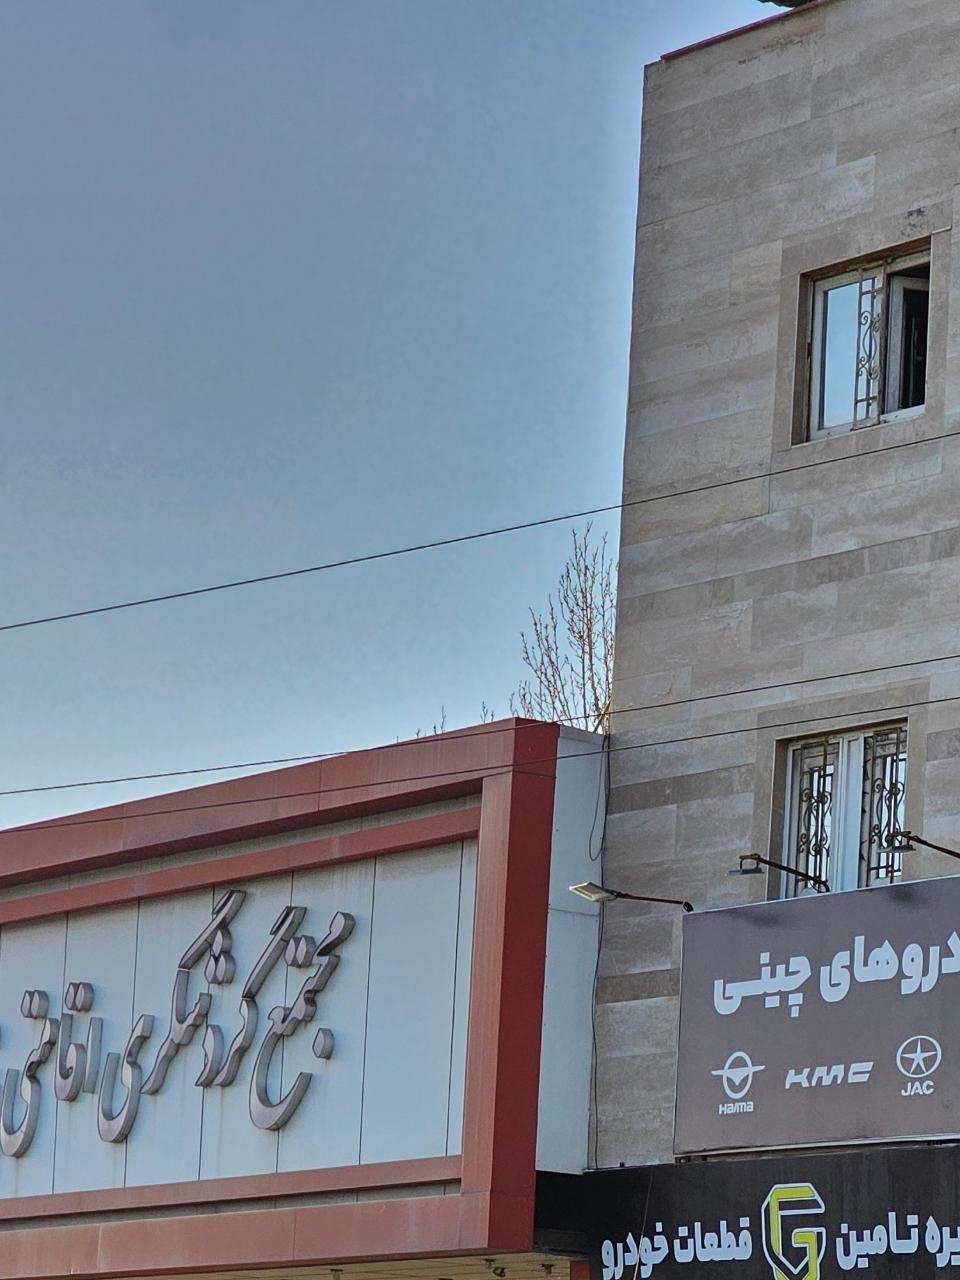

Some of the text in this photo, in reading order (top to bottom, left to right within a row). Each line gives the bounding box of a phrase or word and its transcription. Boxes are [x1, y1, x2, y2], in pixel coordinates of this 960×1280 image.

[713, 951, 812, 1018] چینی
[901, 1080, 934, 1096] JAC
[601, 1222, 669, 1280] خودرو
[673, 1216, 753, 1262] قطعات
[835, 1212, 919, 1270] تامین
